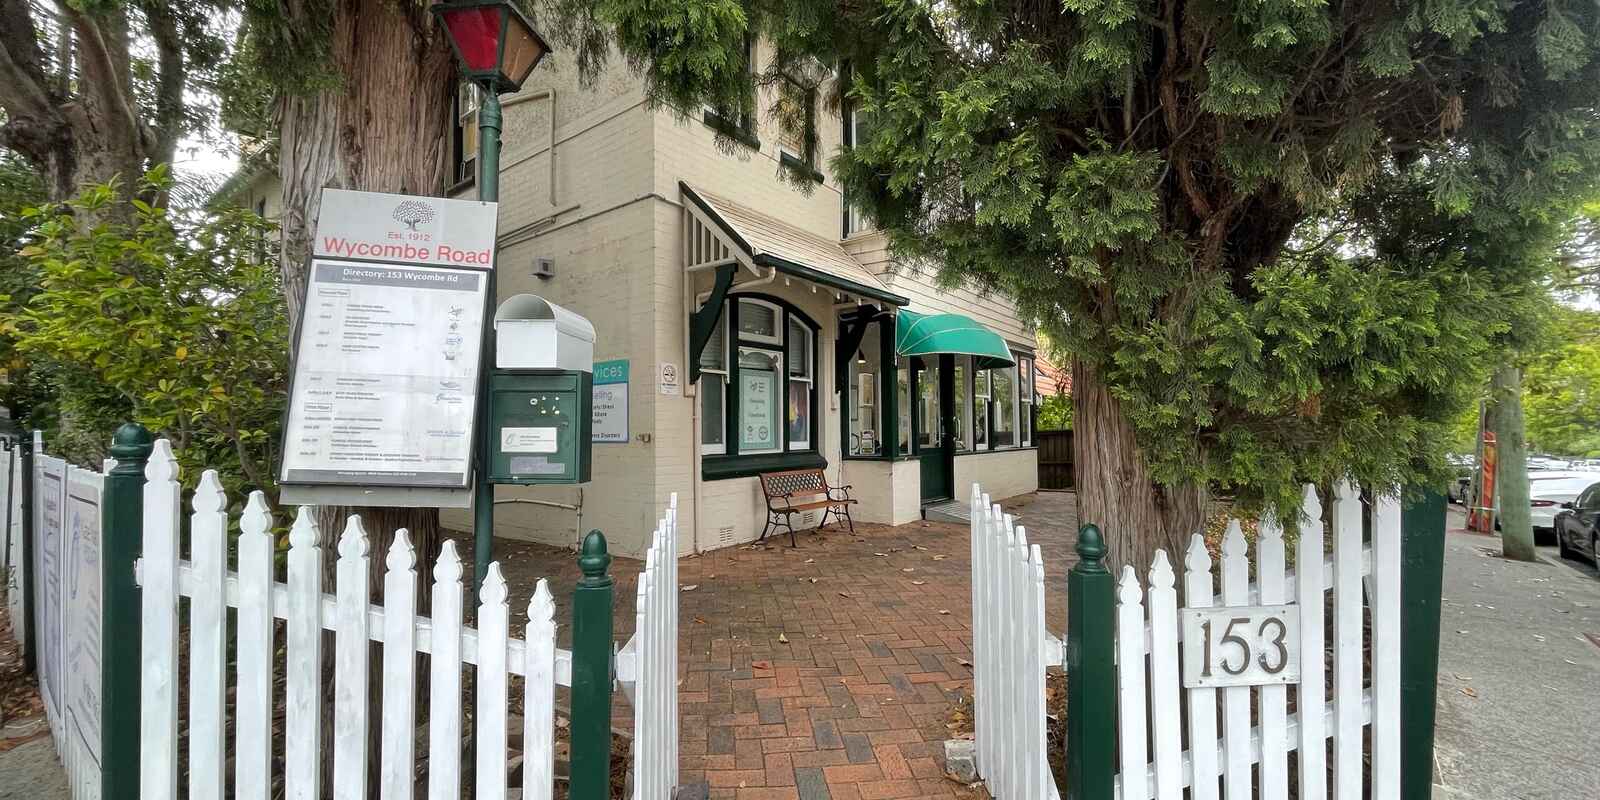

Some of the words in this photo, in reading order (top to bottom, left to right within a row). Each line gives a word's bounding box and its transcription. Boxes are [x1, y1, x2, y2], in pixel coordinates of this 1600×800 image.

[387, 231, 404, 240] Est.
[408, 232, 431, 241] 1912
[323, 236, 430, 260] Wycombe
[437, 245, 491, 264] Road
[343, 268, 385, 279] Directory:
[387, 271, 402, 279] 153
[404, 271, 445, 281] Wycombe
[1200, 616, 1288, 677] 153
